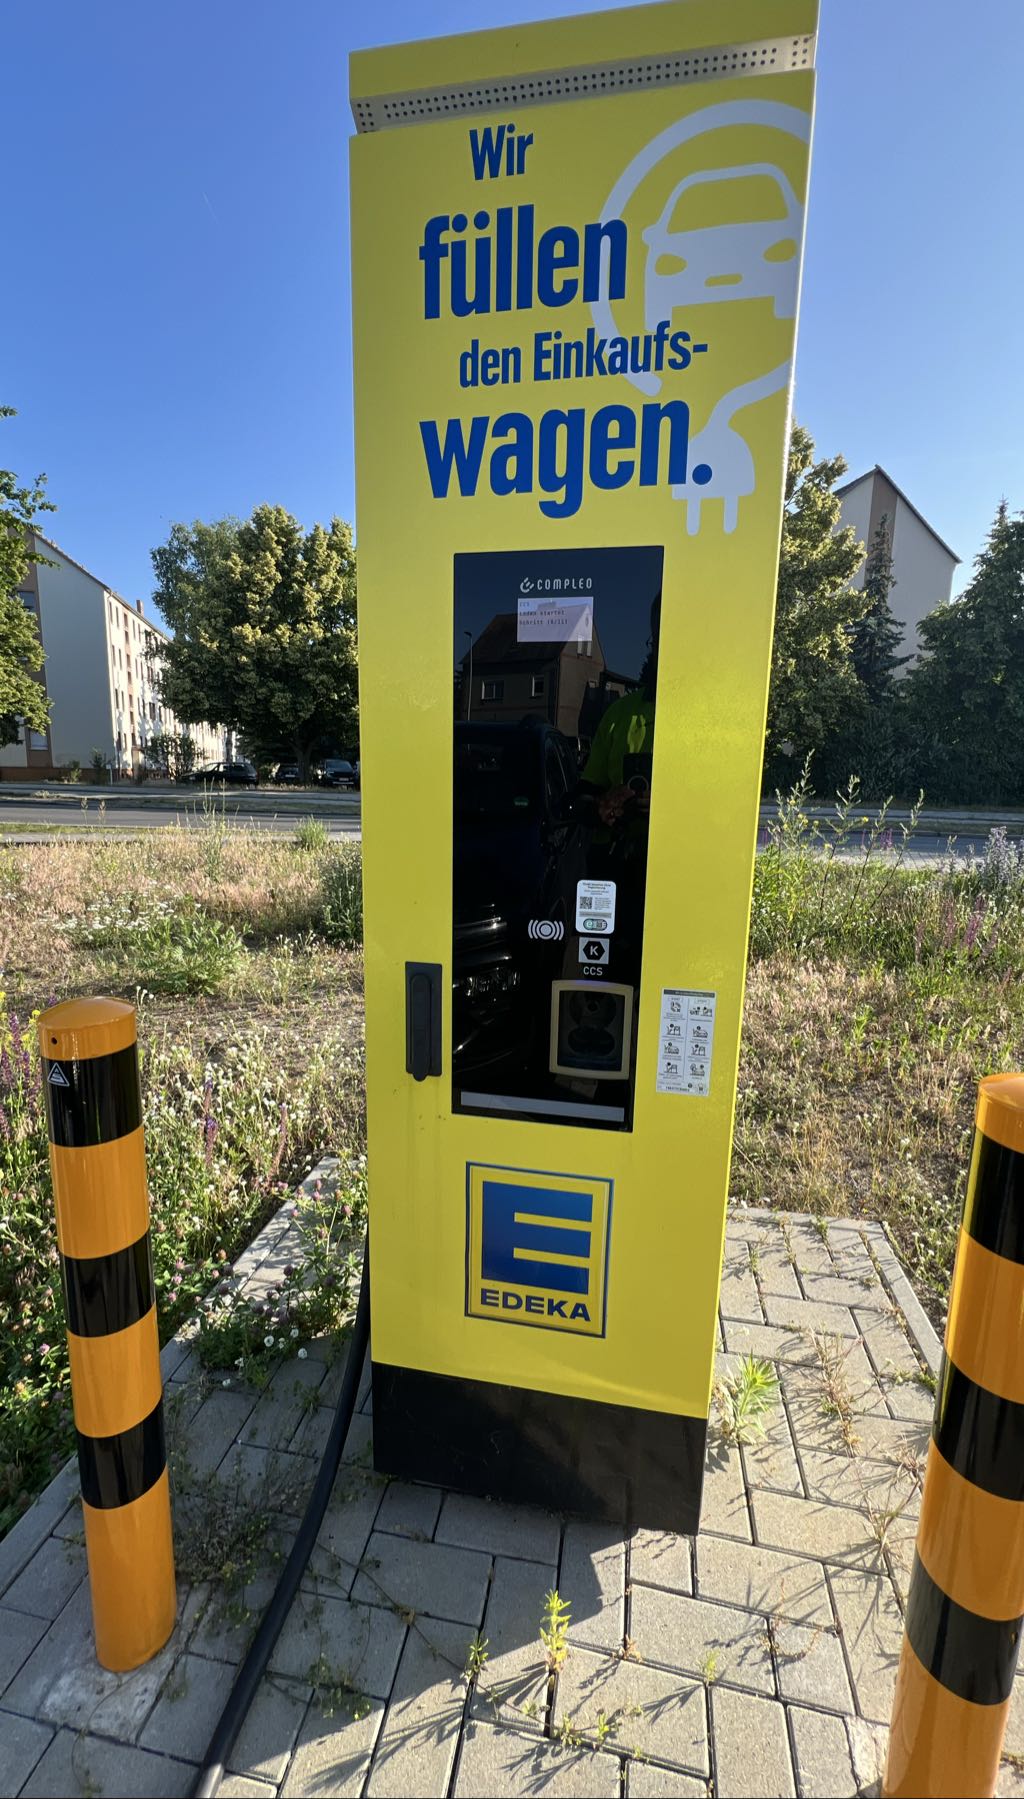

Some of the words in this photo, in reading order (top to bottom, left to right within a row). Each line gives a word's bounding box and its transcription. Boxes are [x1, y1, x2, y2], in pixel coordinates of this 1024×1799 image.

[469, 123, 534, 181] Wir
[418, 204, 628, 320] füllen
[459, 339, 521, 388] den
[533, 320, 708, 382] Einkaufs-
[418, 400, 713, 519] wagen.
[537, 578, 592, 590] COMPLEO
[583, 966, 603, 976] CCS
[589, 945, 599, 956] K
[480, 1288, 591, 1322] EDEKA
